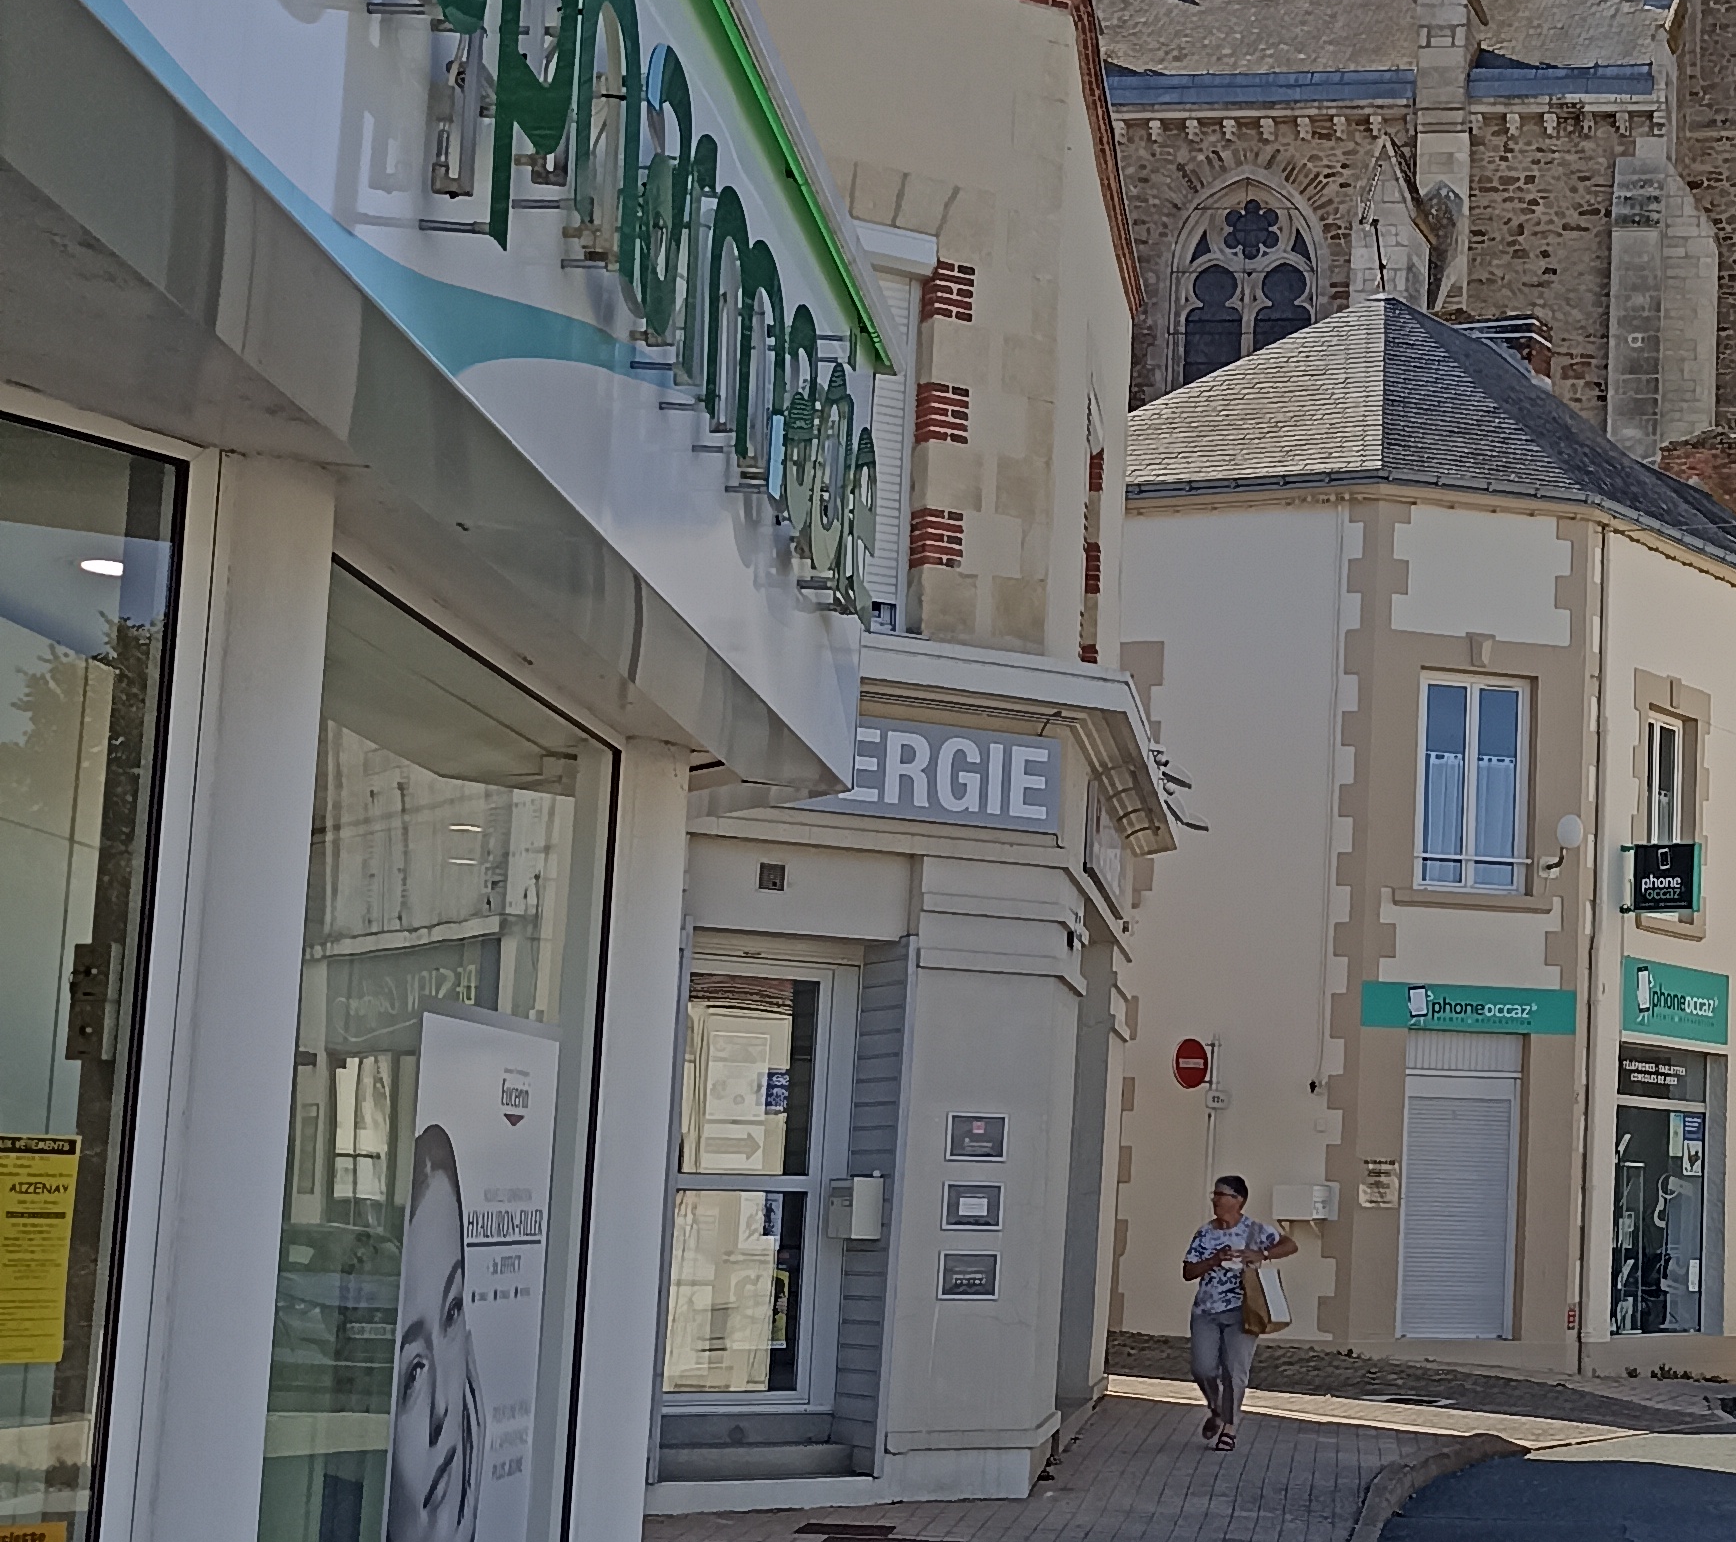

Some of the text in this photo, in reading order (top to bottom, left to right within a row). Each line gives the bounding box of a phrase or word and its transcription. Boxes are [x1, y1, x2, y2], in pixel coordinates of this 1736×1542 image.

[1641, 874, 1681, 895] phone
[1646, 888, 1681, 899] occaz
[1432, 996, 1531, 1021] phoneoccaz
[1652, 982, 1714, 1018] phoneoccaz
[9, 1181, 69, 1195] AIZENAY
[466, 1209, 543, 1238] HYALURON-FILLER
